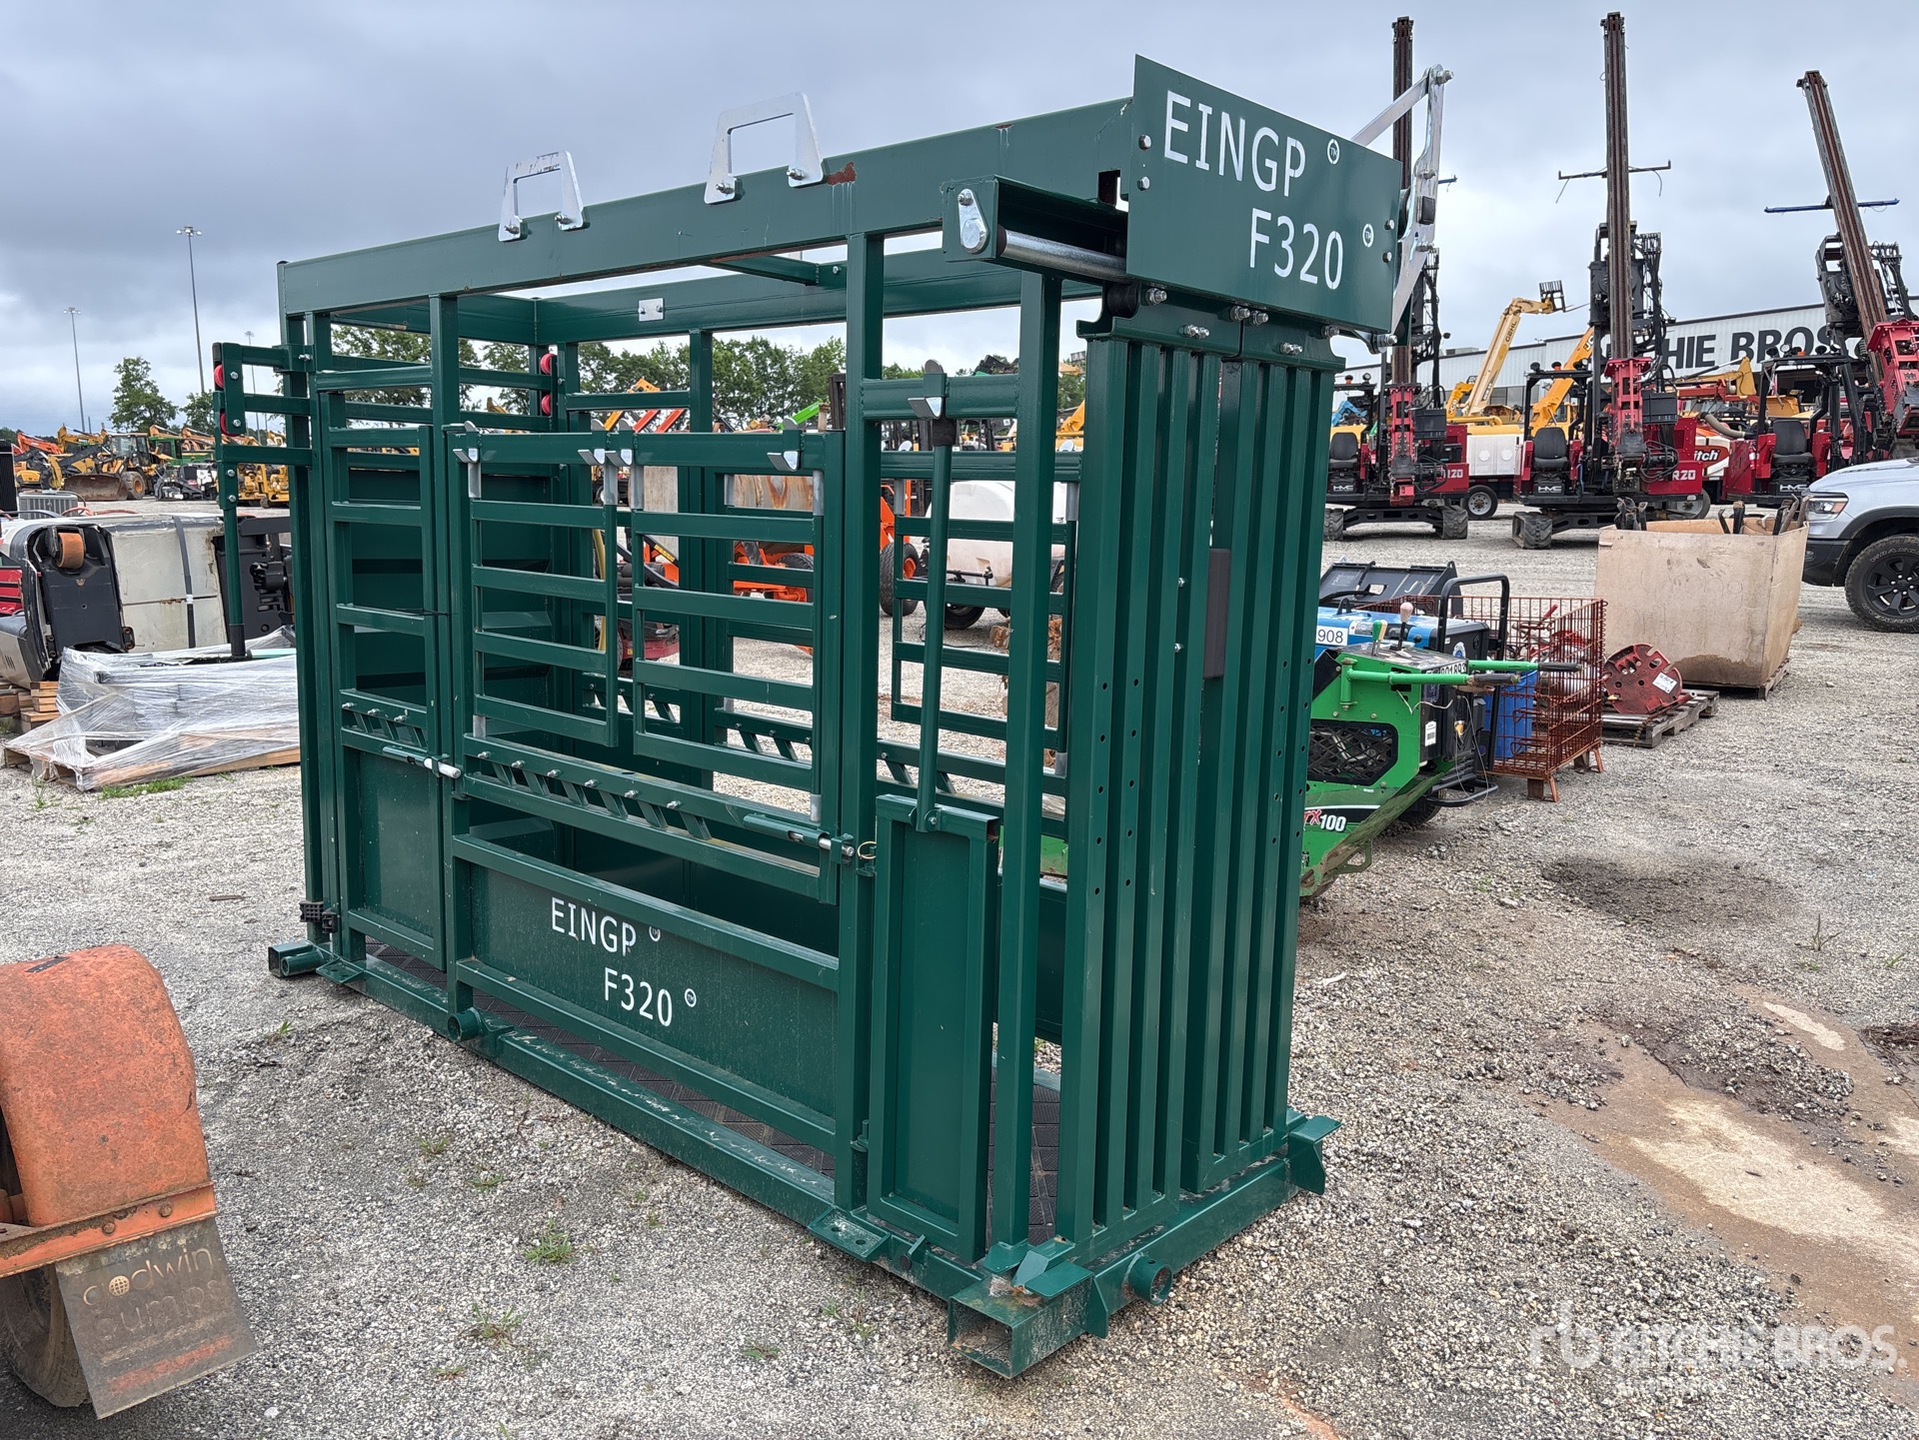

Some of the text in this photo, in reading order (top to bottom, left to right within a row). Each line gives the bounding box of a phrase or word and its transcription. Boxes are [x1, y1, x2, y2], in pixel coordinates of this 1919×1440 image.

[1164, 90, 1306, 197] EINGP
[1250, 208, 1344, 290] F320
[1694, 450, 1719, 461] itch
[1317, 628, 1344, 644] 908
[552, 897, 637, 957] EINGP
[604, 966, 673, 1027] F320
